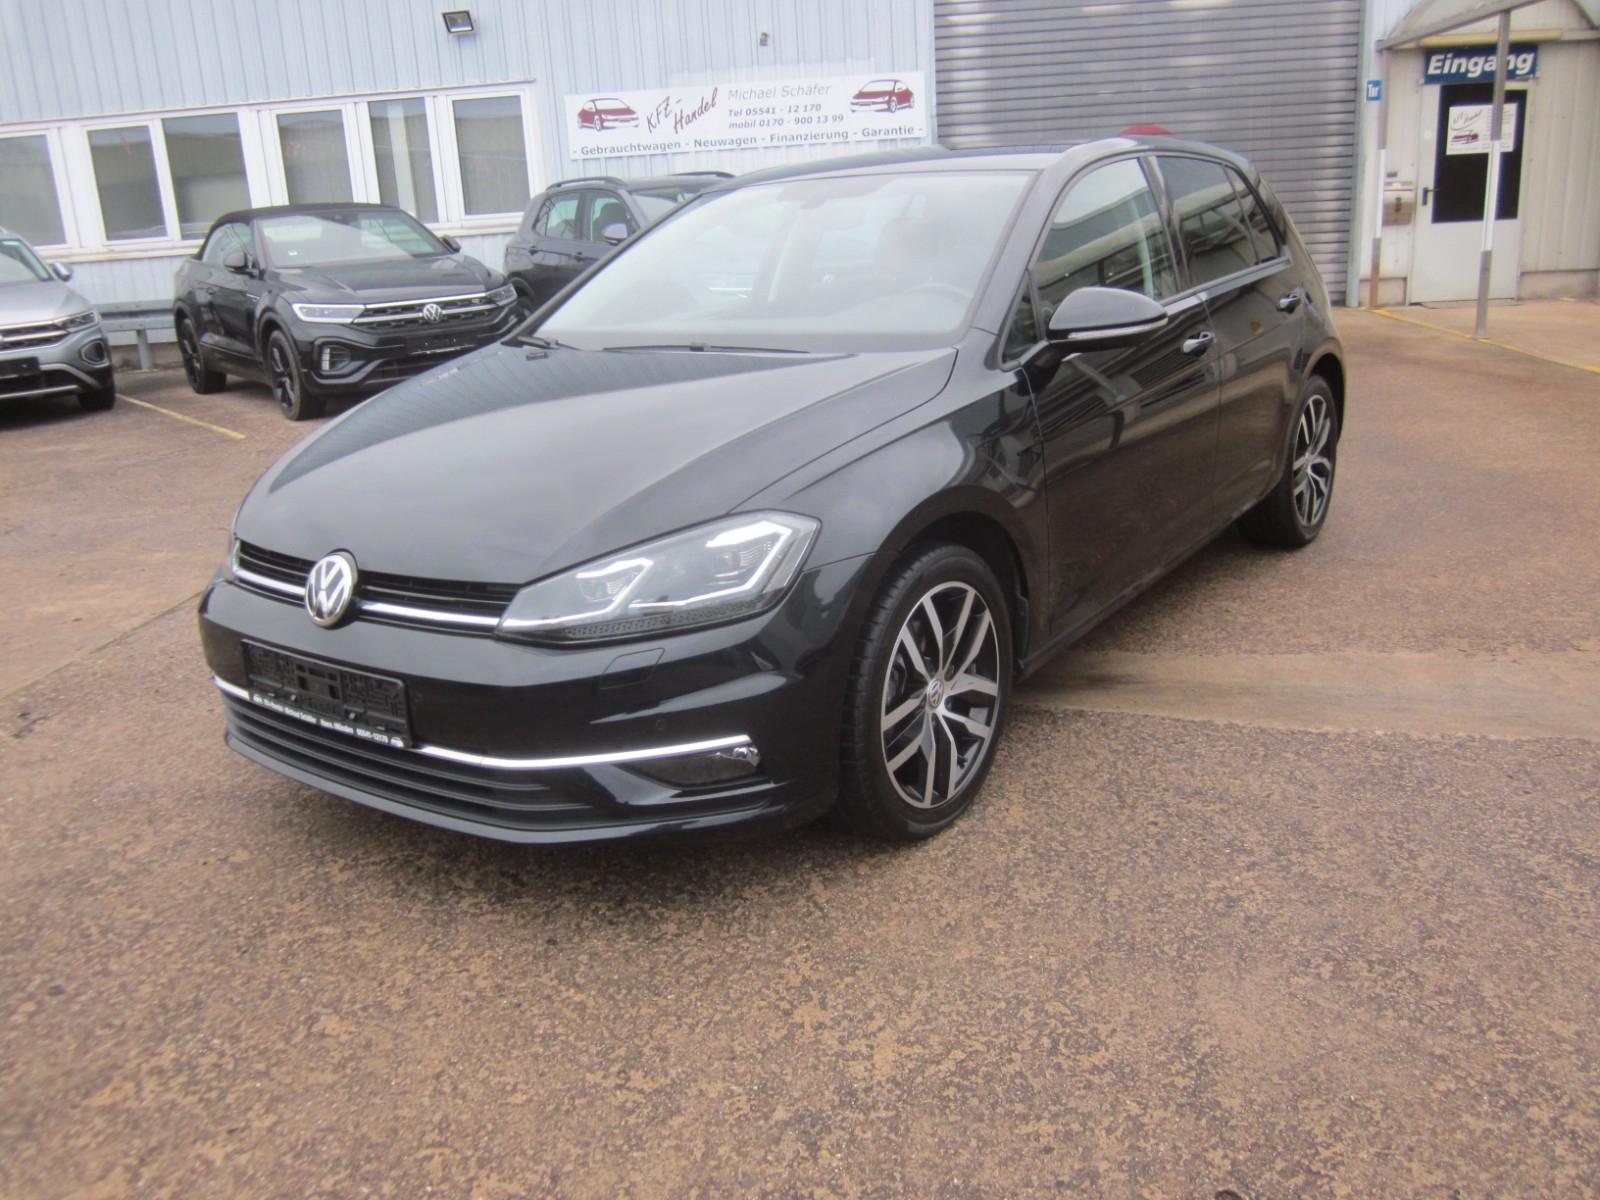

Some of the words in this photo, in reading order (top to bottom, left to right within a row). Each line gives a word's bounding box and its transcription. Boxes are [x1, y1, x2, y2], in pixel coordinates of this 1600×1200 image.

[1427, 52, 1536, 78] Eingang
[727, 86, 777, 101] Michael
[672, 87, 719, 135] Handel
[745, 107, 776, 116] 05541
[788, 104, 800, 113] 12
[803, 103, 822, 112] 170
[728, 120, 757, 130] mobil
[759, 118, 784, 127] 0170
[794, 116, 814, 126] 900
[817, 115, 829, 124] 13
[832, 114, 845, 123] 99
[580, 141, 681, 155] Gebrauchtwagen
[694, 135, 758, 148] Neuwagen
[769, 130, 849, 143] Finanzierung
[862, 124, 915, 137] Garantie
